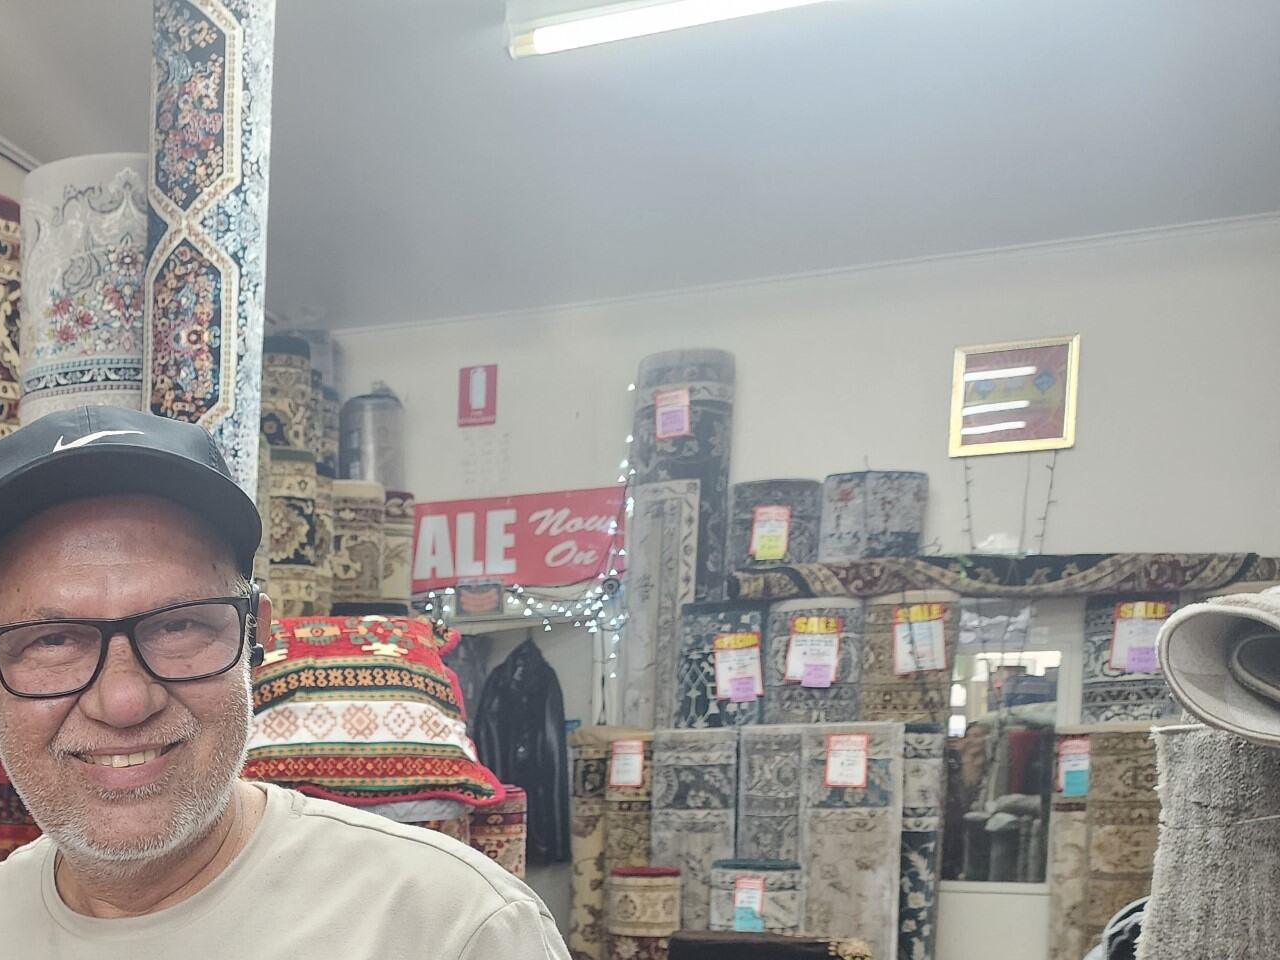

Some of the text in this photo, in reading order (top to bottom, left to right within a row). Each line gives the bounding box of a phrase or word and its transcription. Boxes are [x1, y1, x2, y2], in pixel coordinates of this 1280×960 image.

[528, 507, 617, 536] Now
[413, 508, 517, 580] ALE
[544, 540, 599, 567] On
